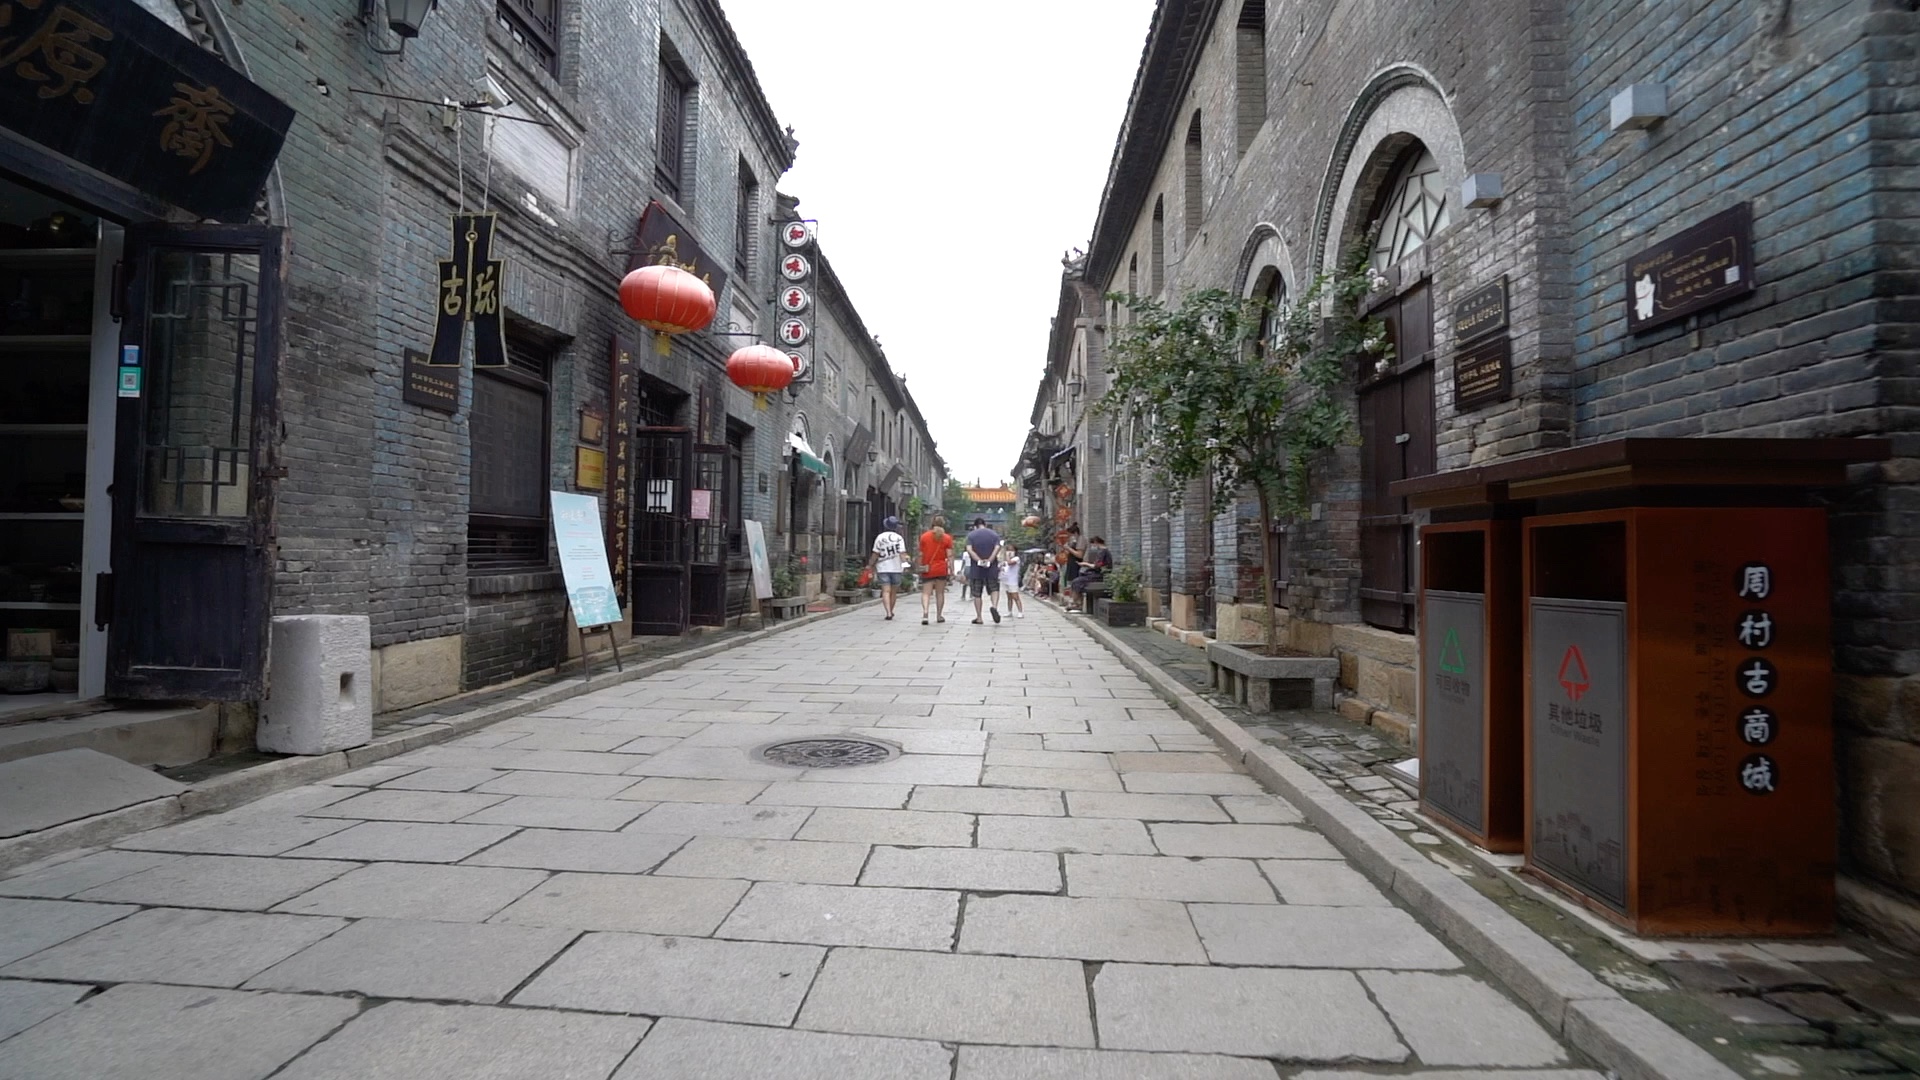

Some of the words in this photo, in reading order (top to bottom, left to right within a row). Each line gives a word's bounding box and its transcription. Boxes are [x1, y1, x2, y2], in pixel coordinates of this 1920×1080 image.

[1435, 673, 1470, 697] 可回收物
[1738, 565, 1775, 791] 周村古商城
[1548, 702, 1603, 734] 其他垃圾
